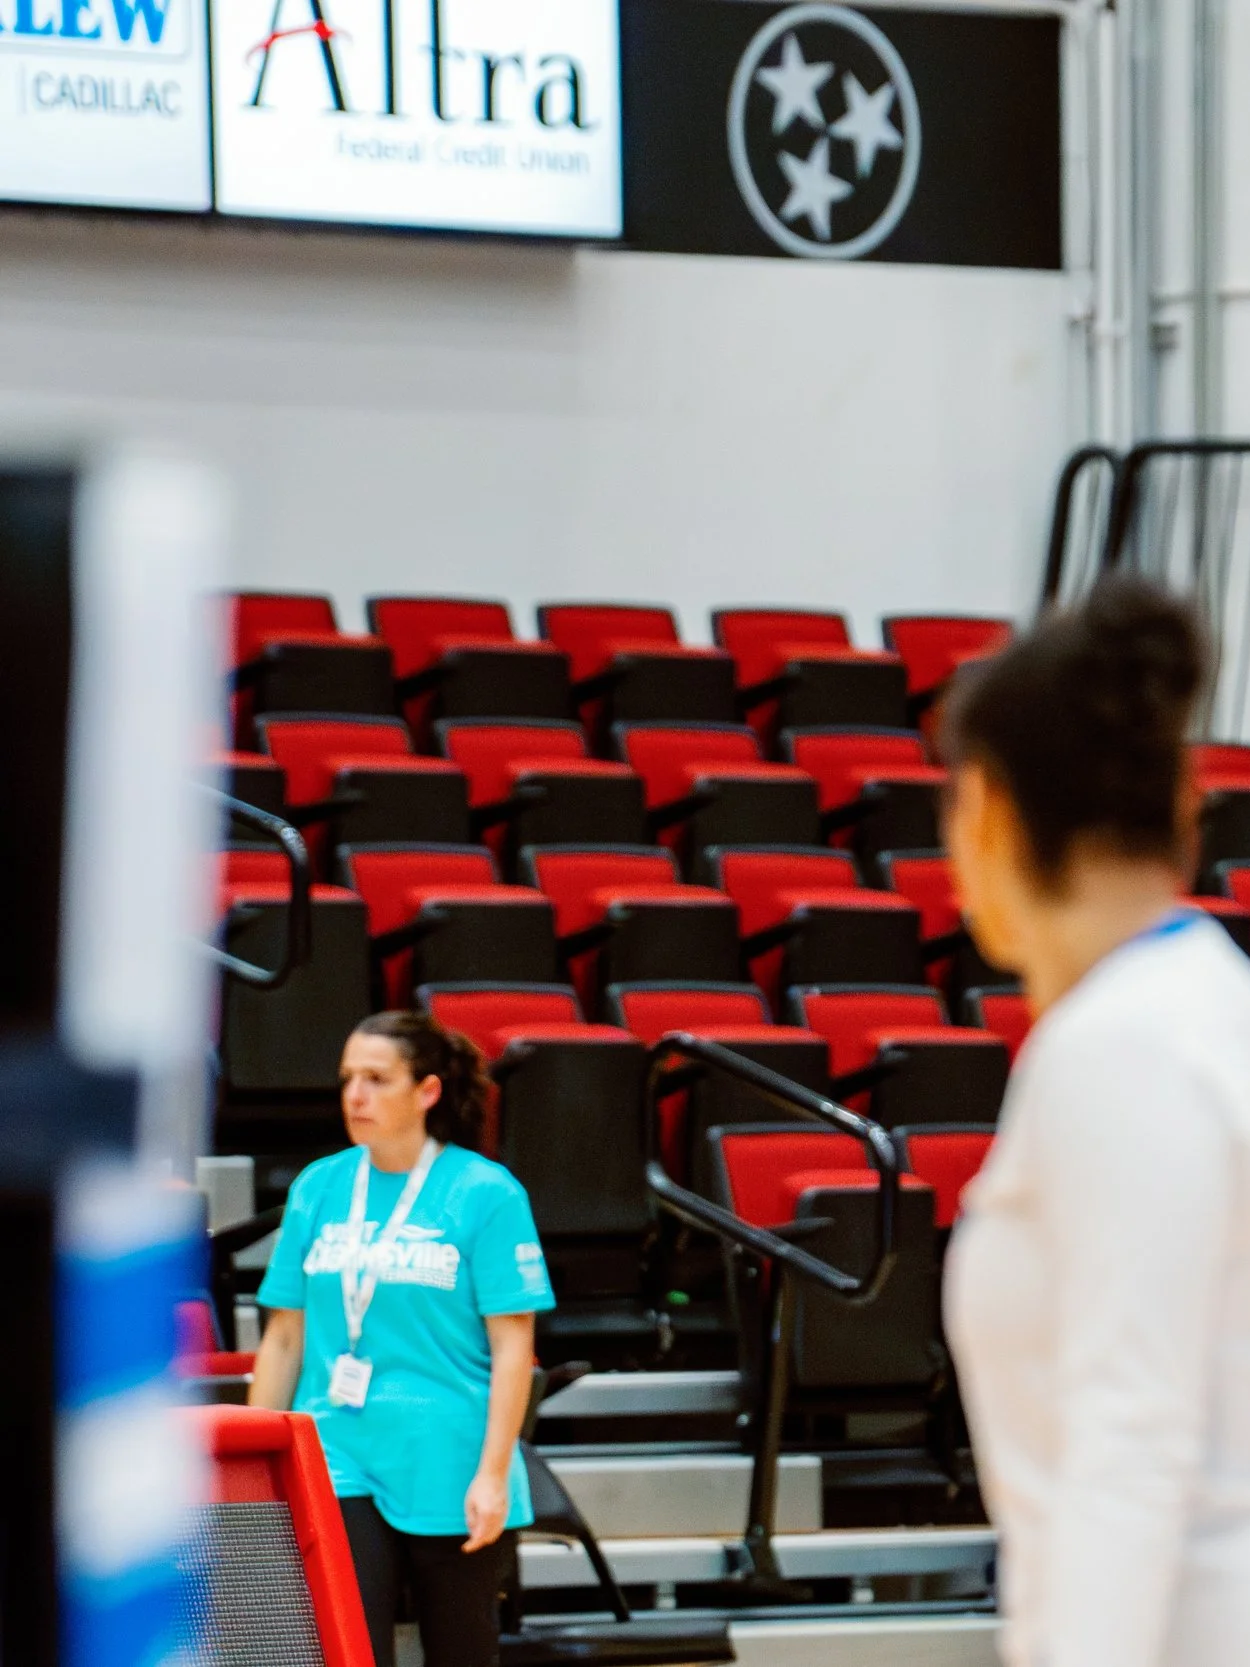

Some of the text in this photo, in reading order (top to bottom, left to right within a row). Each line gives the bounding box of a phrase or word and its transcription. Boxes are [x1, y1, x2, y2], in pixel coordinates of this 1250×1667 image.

[0, 0, 171, 44] LEW
[239, 0, 599, 133] Altra
[33, 70, 182, 119] CADILLAC
[336, 131, 591, 175] Federal Credit Union
